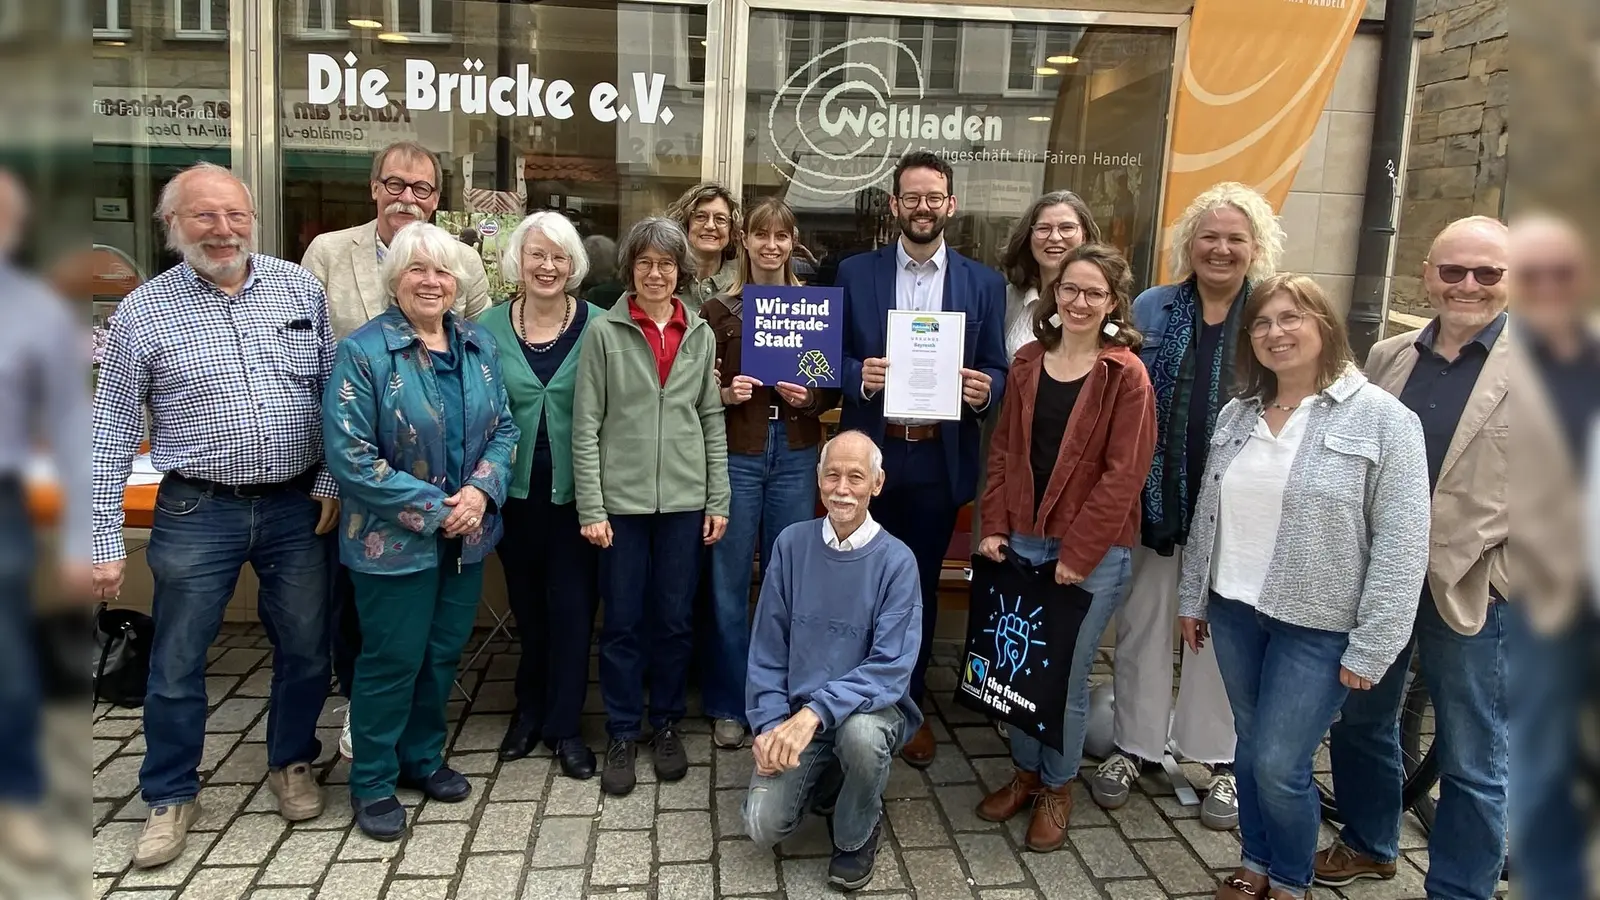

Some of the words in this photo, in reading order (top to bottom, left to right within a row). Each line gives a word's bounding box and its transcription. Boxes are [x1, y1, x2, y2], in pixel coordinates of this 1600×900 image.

[308, 51, 390, 109] Die
[405, 57, 575, 119] Brücke
[589, 72, 674, 125] e.V.
[92, 100, 112, 114] für
[119, 101, 163, 116] Fairen
[169, 104, 219, 120] Handel
[819, 96, 1002, 141] Weltladen
[1017, 149, 1038, 163] für
[1044, 150, 1086, 164] Fairen
[1093, 152, 1143, 166] Handel
[755, 297, 789, 315] Wir
[791, 298, 830, 316] sind
[755, 315, 829, 331] Fairtrade-
[754, 331, 803, 348] Stadt
[983, 689, 992, 704] is
[992, 696, 1012, 714] fair
[987, 676, 1003, 694] the
[1003, 685, 1037, 713] future
